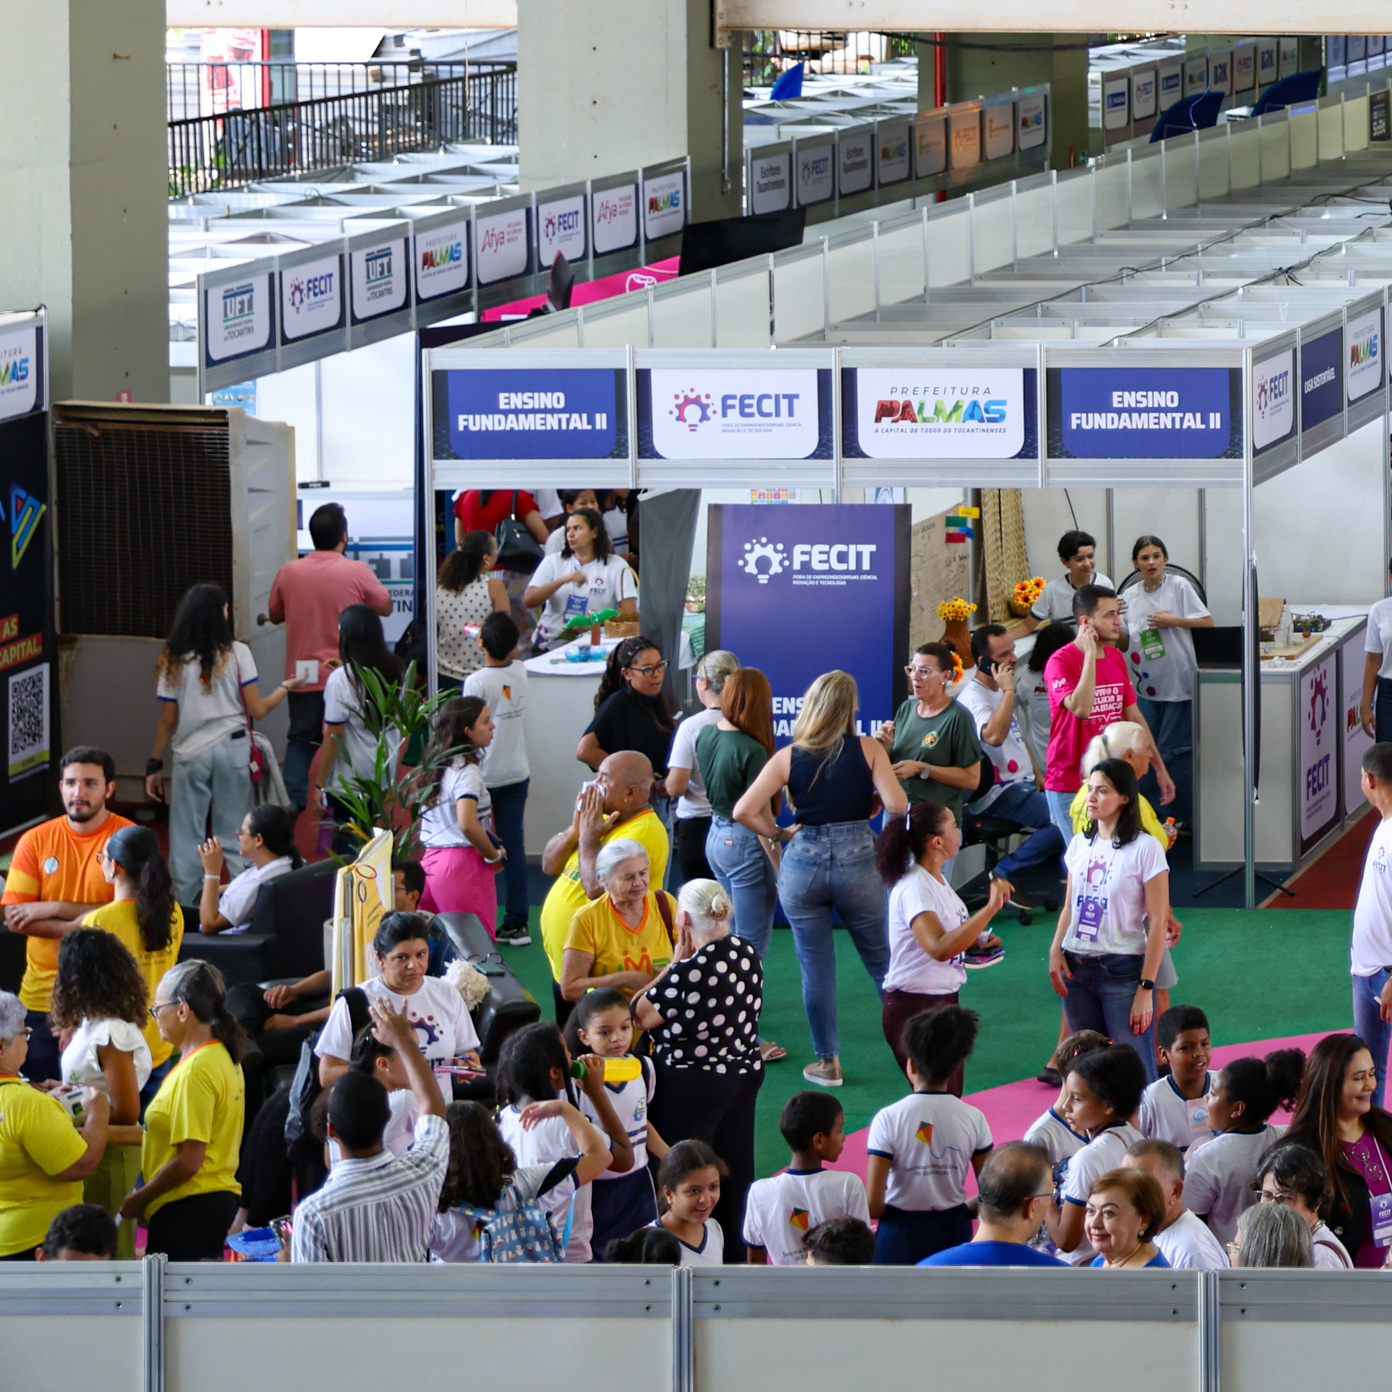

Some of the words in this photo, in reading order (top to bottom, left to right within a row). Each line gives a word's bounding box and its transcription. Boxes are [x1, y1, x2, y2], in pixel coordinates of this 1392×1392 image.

[597, 201, 617, 224] Afya
[649, 190, 680, 214] PALMAS
[558, 210, 579, 232] FECIT
[481, 227, 505, 253] Afya
[421, 242, 462, 271] PALMAS
[307, 273, 333, 296] FECIT
[1350, 334, 1378, 369] PALMAS
[890, 386, 992, 396] PREFEITURA
[1269, 370, 1289, 403] FECIT
[1304, 378, 1313, 394] CASA
[1313, 366, 1336, 390] SUSTENTÁVEL
[499, 391, 565, 409] ENSINO
[721, 393, 800, 418] FECIT
[1112, 390, 1179, 408] ENSINO
[458, 412, 590, 432] FUNDAMENTAL
[595, 412, 607, 430] II
[874, 399, 1007, 424] PALMAS
[1070, 412, 1206, 430] FUNDAMENTAL
[1209, 412, 1221, 429] II
[793, 544, 876, 570] FECIT
[2, 622, 18, 639] AS
[1306, 753, 1330, 801] FECIT
[1373, 860, 1387, 873] FECIT
[1379, 1208, 1392, 1218] FECIT
